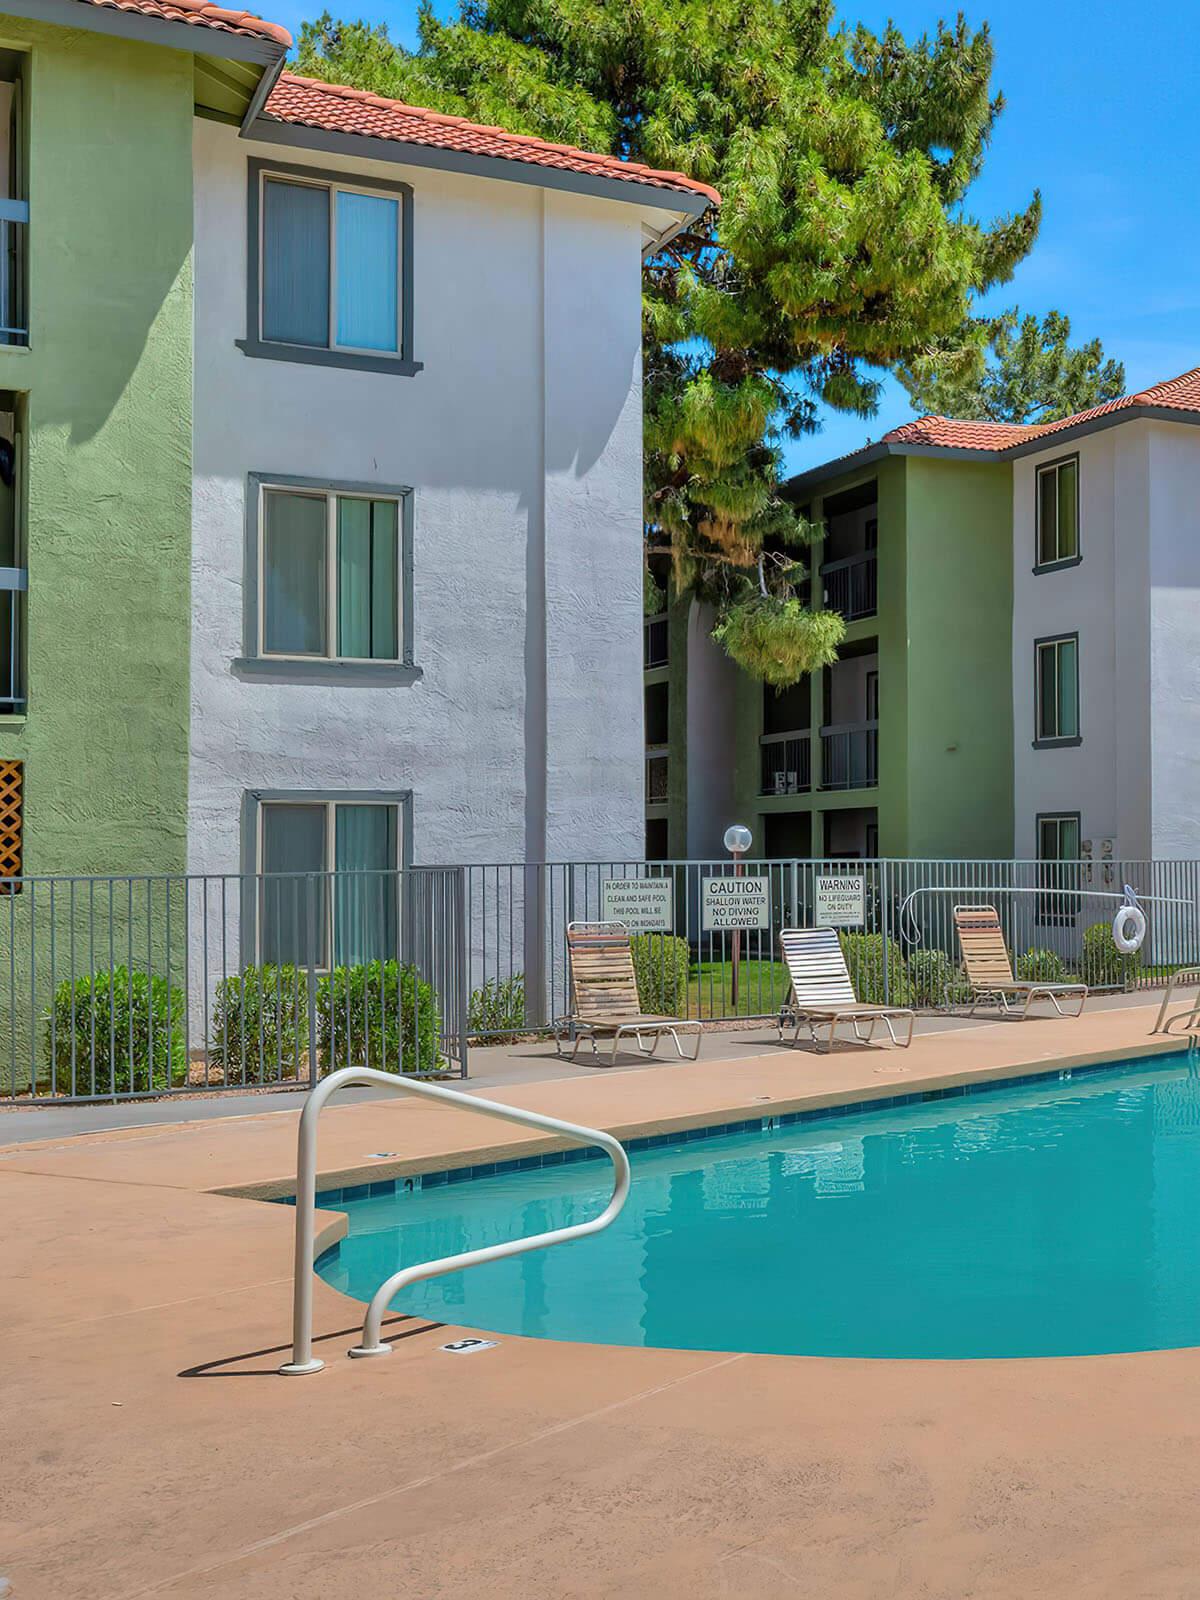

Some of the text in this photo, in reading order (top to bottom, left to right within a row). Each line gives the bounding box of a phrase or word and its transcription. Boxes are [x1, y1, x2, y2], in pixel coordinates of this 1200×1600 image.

[612, 882, 630, 890] ORDER
[631, 882, 639, 890] TO
[640, 881, 663, 889] MAINTAIN
[710, 881, 762, 894] CAUTION
[819, 879, 861, 890] WARNING
[608, 895, 625, 903] CLEAN
[638, 894, 651, 902] SAFE
[652, 894, 667, 902] POOL
[705, 896, 766, 906] SHALLOW WATER
[828, 894, 861, 902] LIFEGUARD
[613, 907, 625, 915] THIS
[712, 907, 759, 916] NO DIVING
[827, 903, 836, 911] ON
[631, 919, 639, 927] ON
[713, 917, 759, 926] ALLOWED
